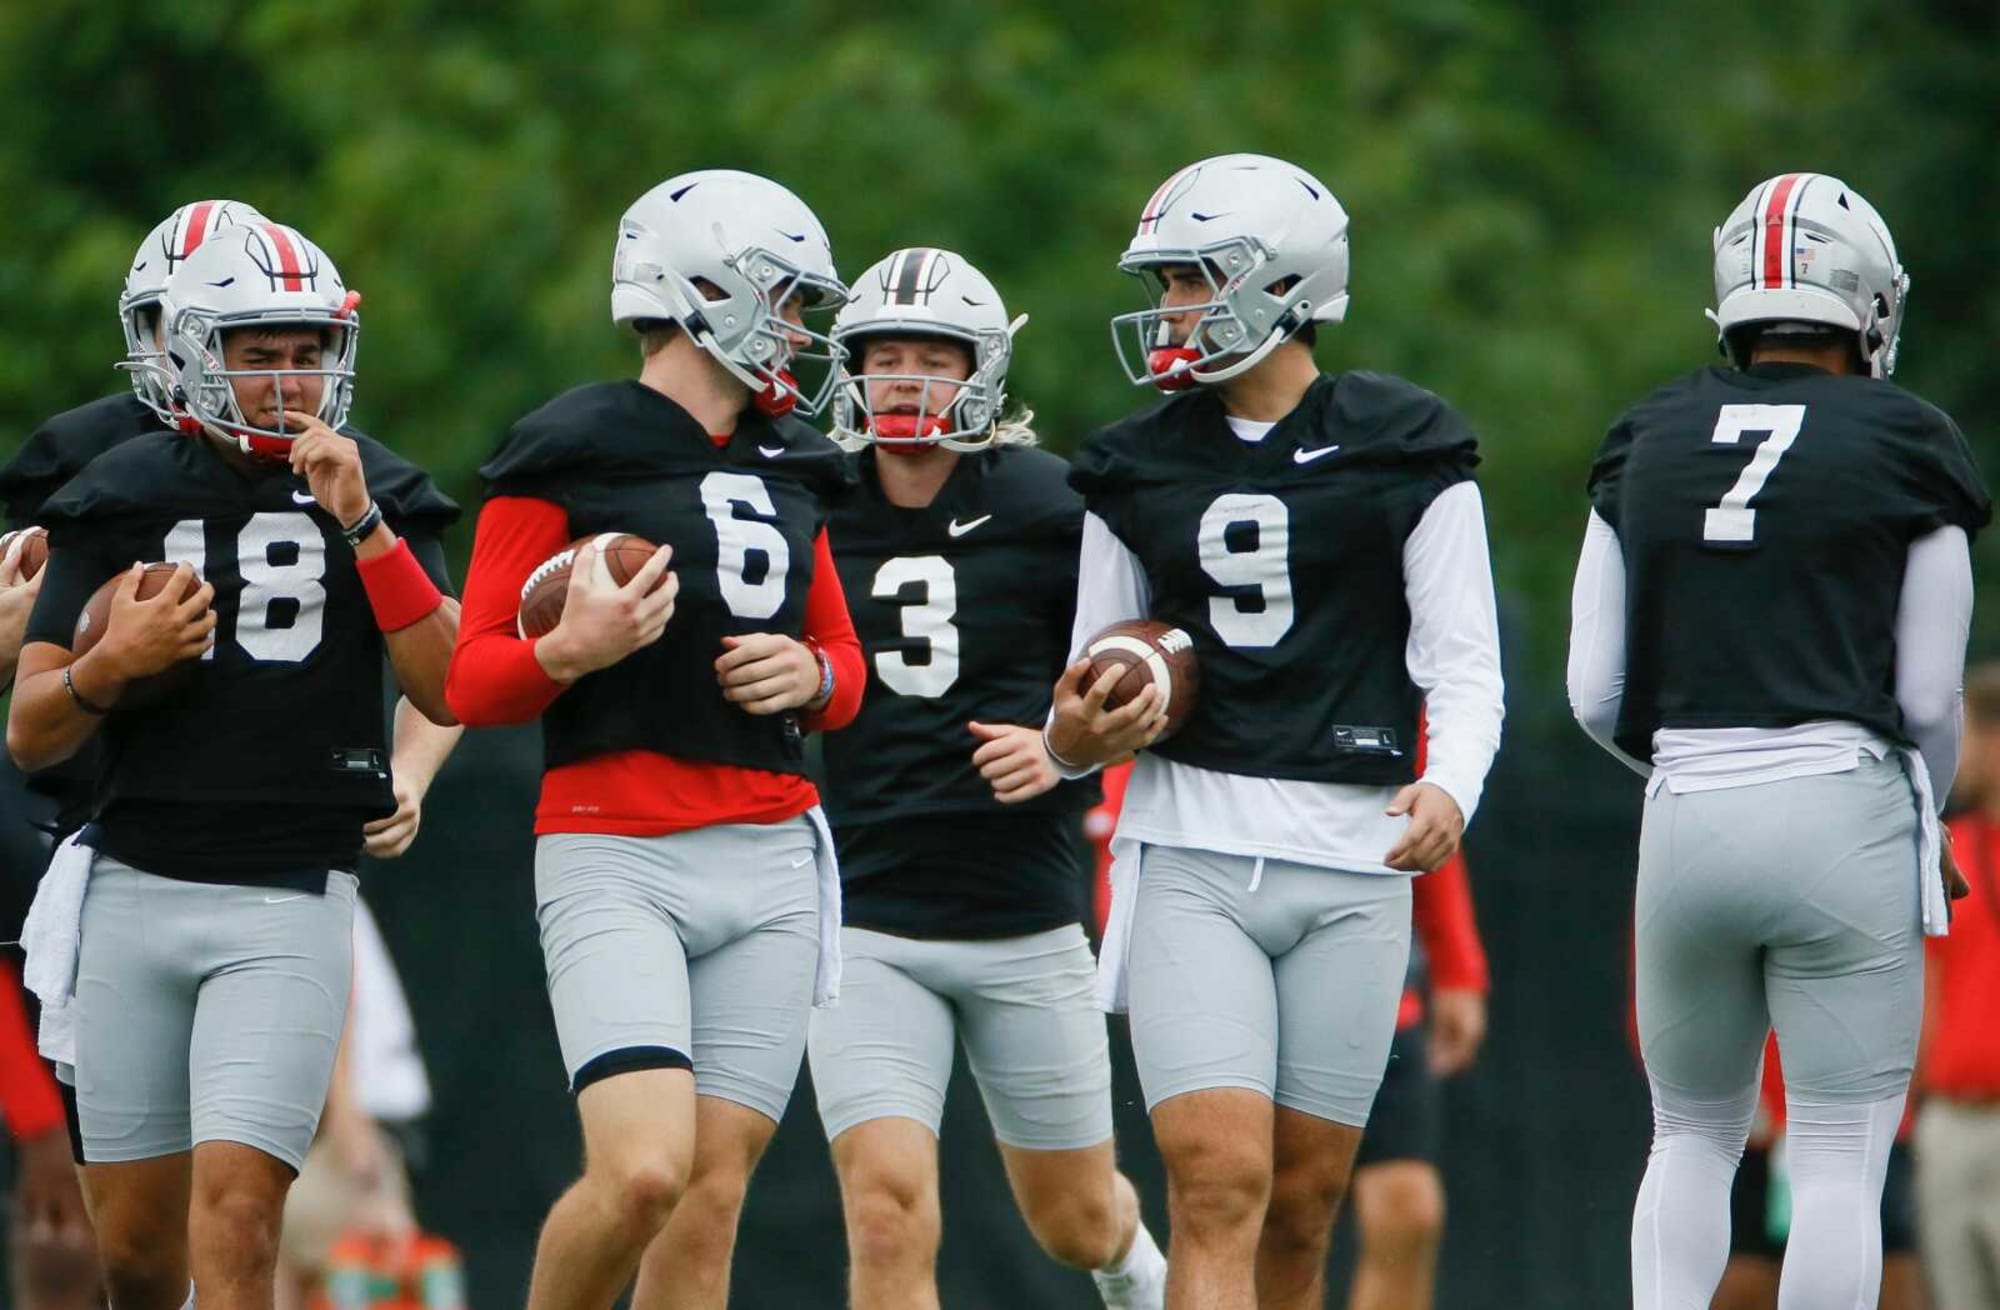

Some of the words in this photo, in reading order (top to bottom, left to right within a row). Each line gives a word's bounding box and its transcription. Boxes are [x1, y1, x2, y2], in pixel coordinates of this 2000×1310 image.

[698, 472, 790, 619] 6
[1704, 404, 1806, 541] 7
[163, 512, 326, 663] 18
[872, 556, 959, 698] 3
[1198, 494, 1294, 648] 9
